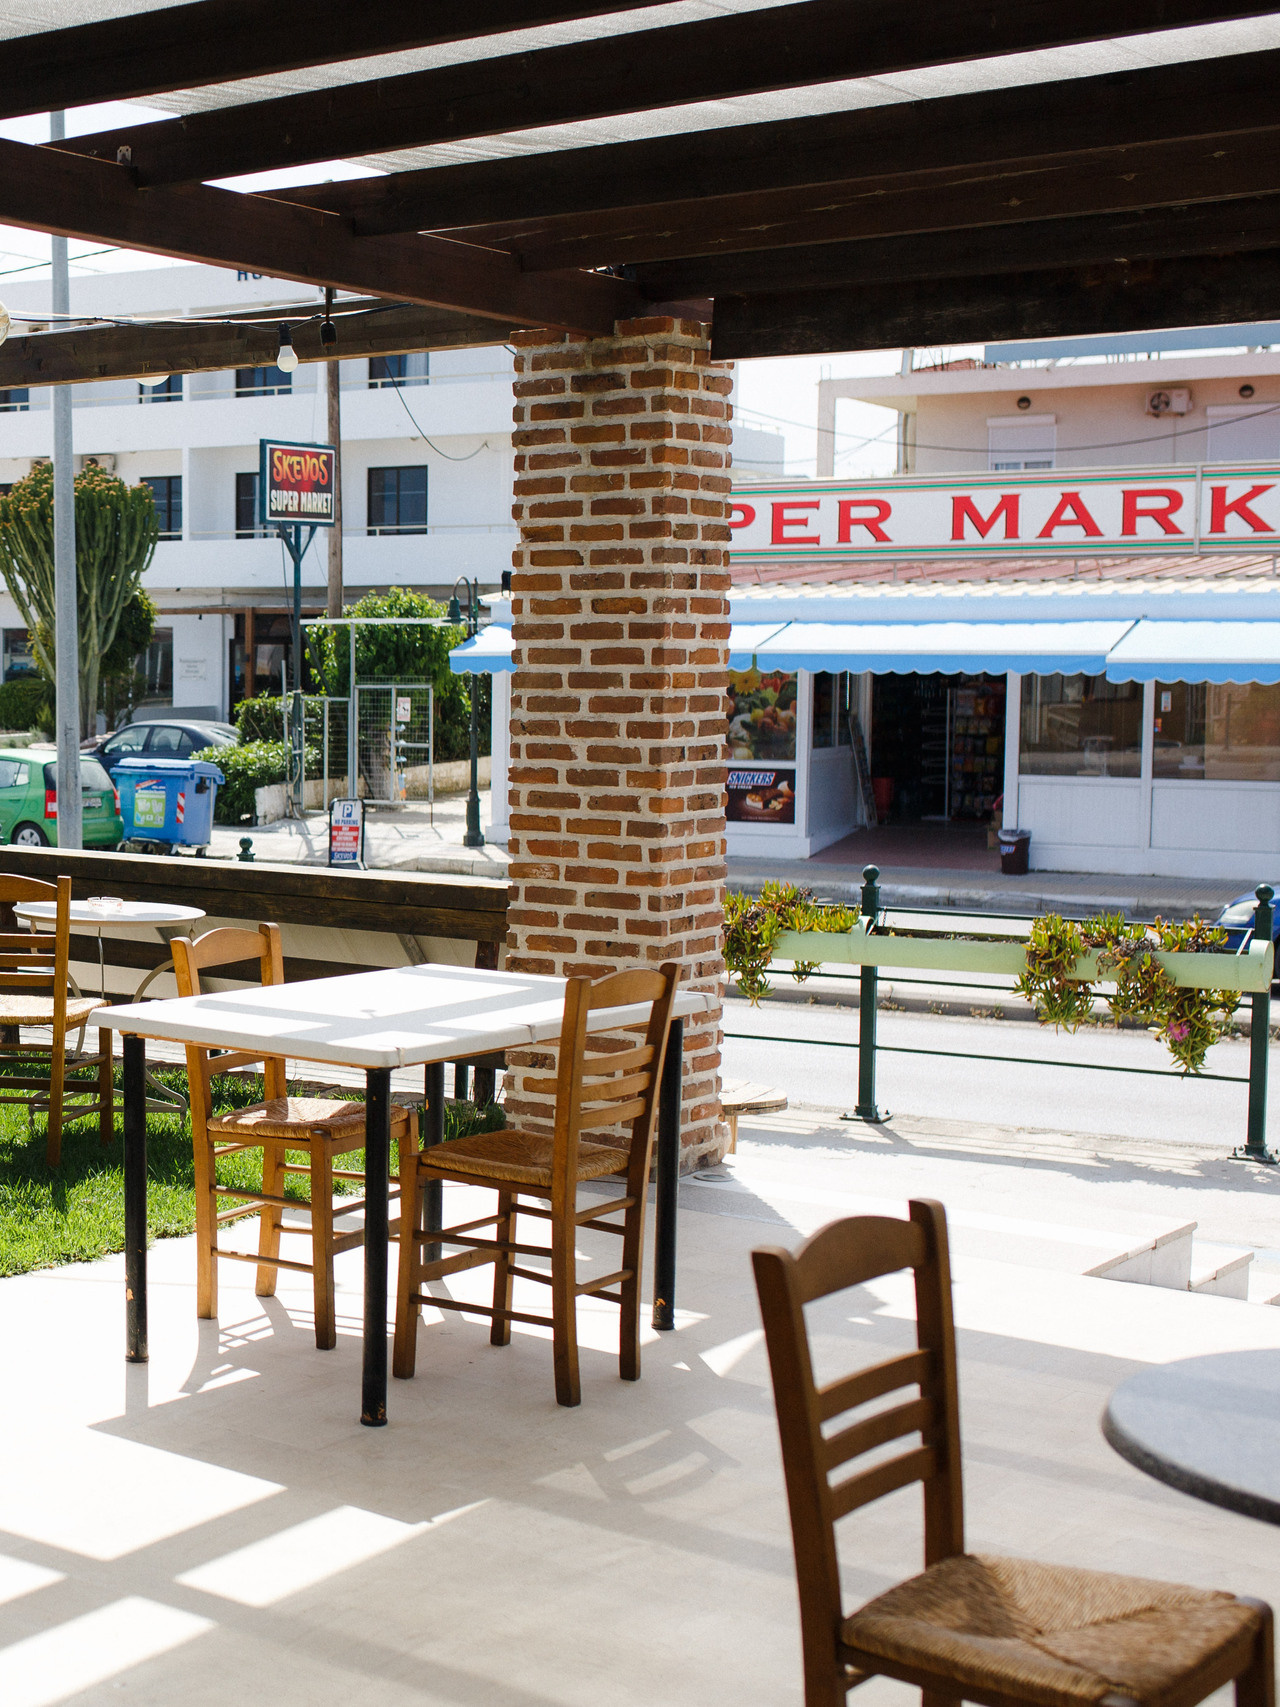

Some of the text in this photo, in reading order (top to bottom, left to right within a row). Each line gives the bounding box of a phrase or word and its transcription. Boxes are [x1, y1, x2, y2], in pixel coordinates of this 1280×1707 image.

[273, 450, 328, 485] SKEVOS
[270, 489, 332, 514] SUPER MARKET
[951, 485, 1277, 540] MARK
[728, 772, 774, 785] SNICKERS
[344, 805, 351, 817] P
